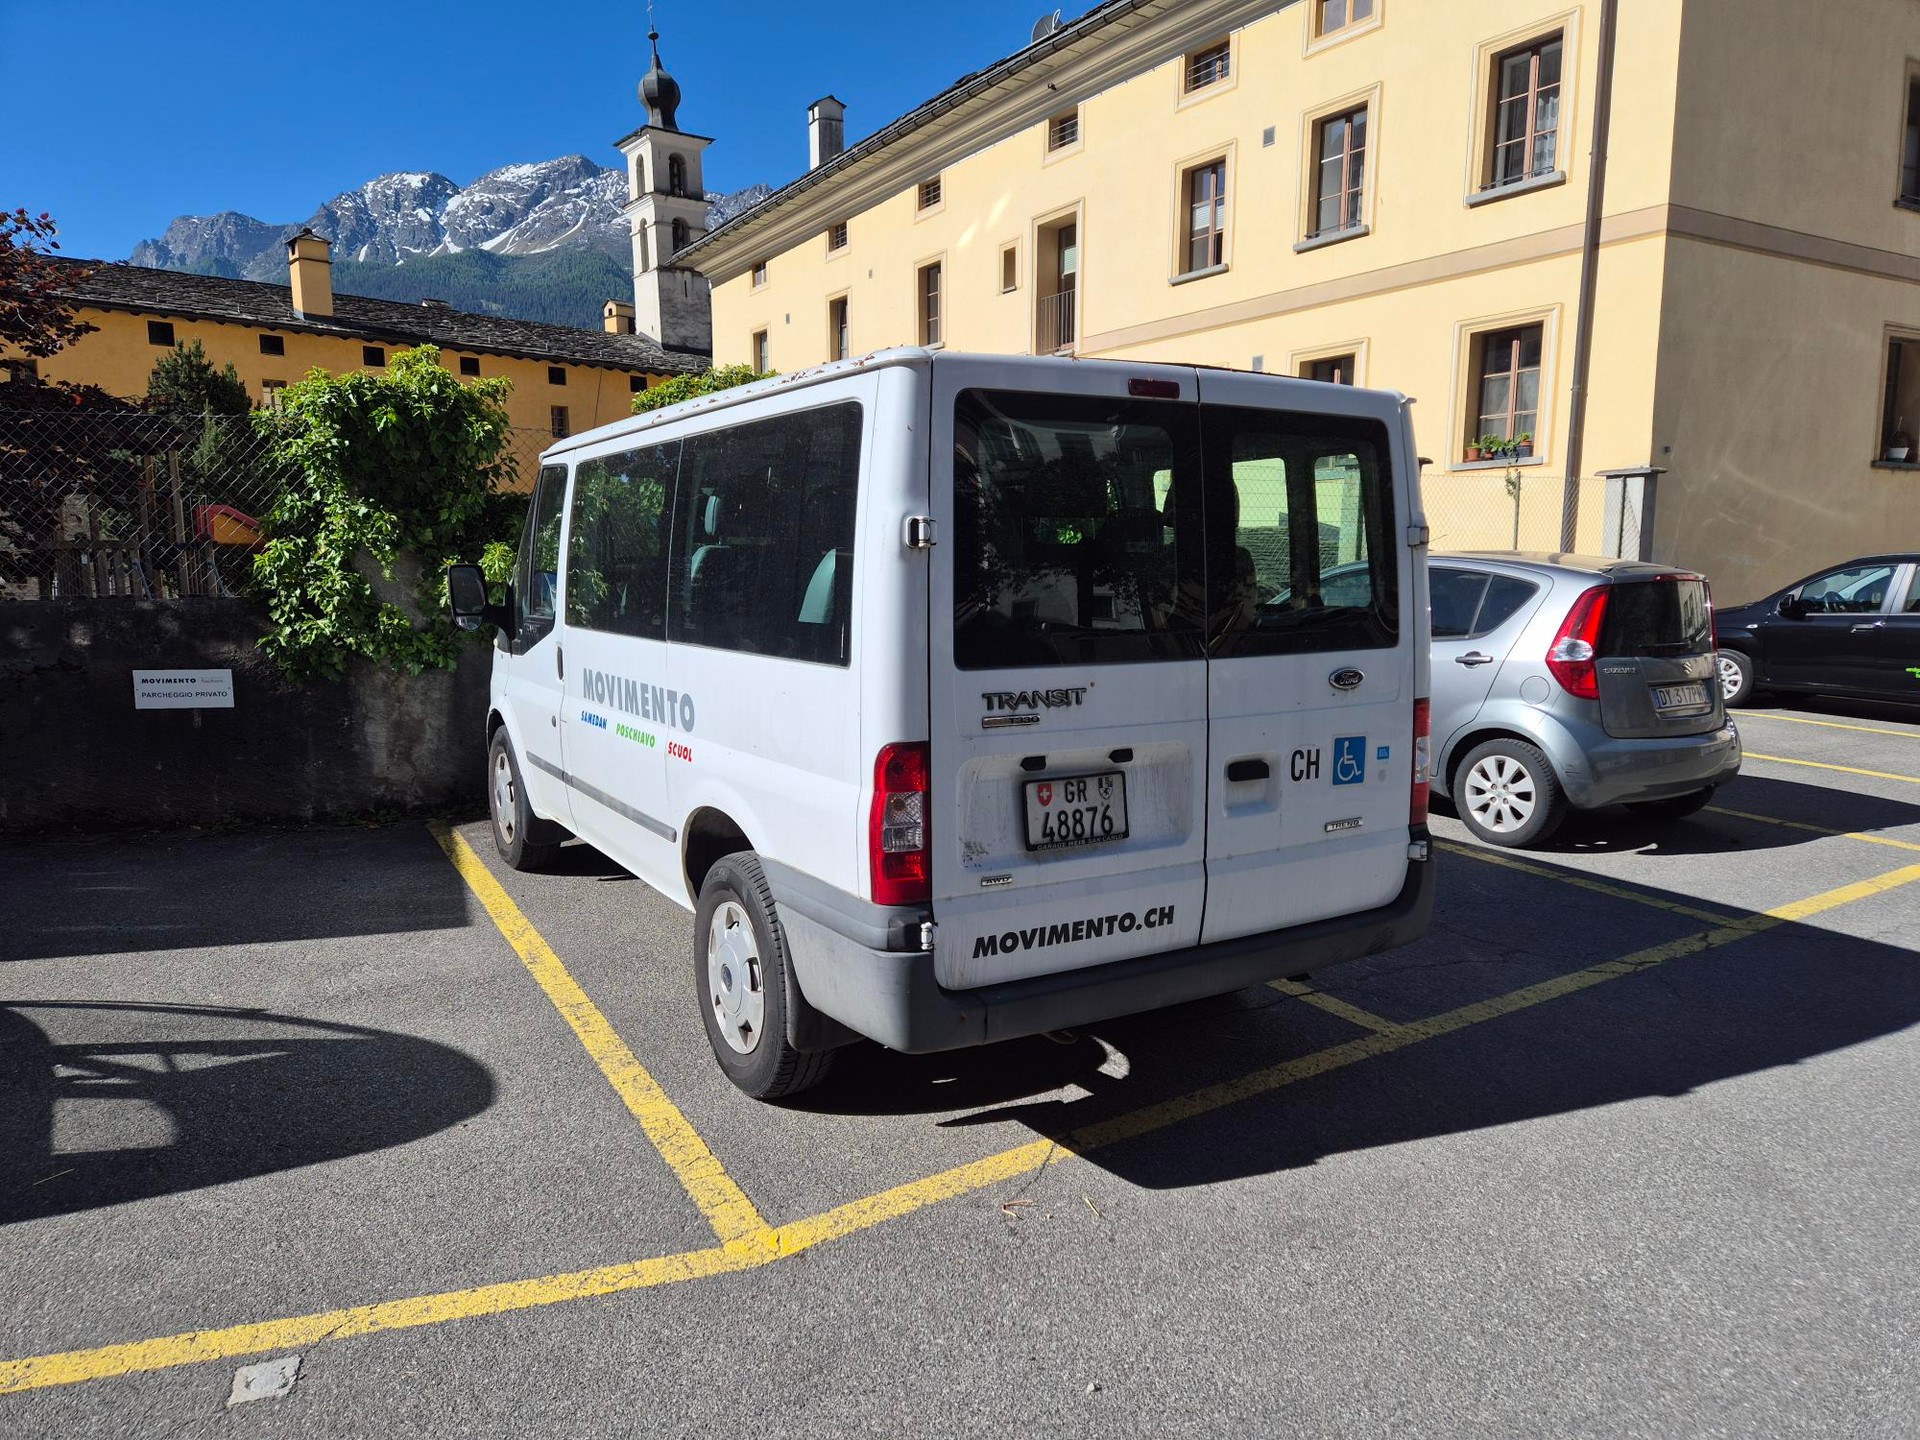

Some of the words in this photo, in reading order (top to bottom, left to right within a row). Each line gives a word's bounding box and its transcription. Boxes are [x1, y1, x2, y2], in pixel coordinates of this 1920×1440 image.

[141, 691, 193, 699] PARCHEGGIO
[195, 690, 228, 698] PRIVATO
[583, 668, 695, 733] MOVIMENTO
[982, 688, 1087, 711] TRANSIT
[1659, 689, 1672, 705] DY
[581, 710, 607, 730] SAMEDAN
[1010, 715, 1040, 724] T330
[616, 723, 656, 748] POSCHIAVO
[668, 741, 692, 762] SCUOL
[1291, 749, 1320, 782] CH
[1064, 780, 1087, 803] GR
[1042, 804, 1113, 842] 48876
[1331, 819, 1359, 829] TREND
[1037, 842, 1067, 850] GARAGE
[986, 876, 1010, 884] AWD
[973, 905, 1174, 958] MOVIMENTO.CH
